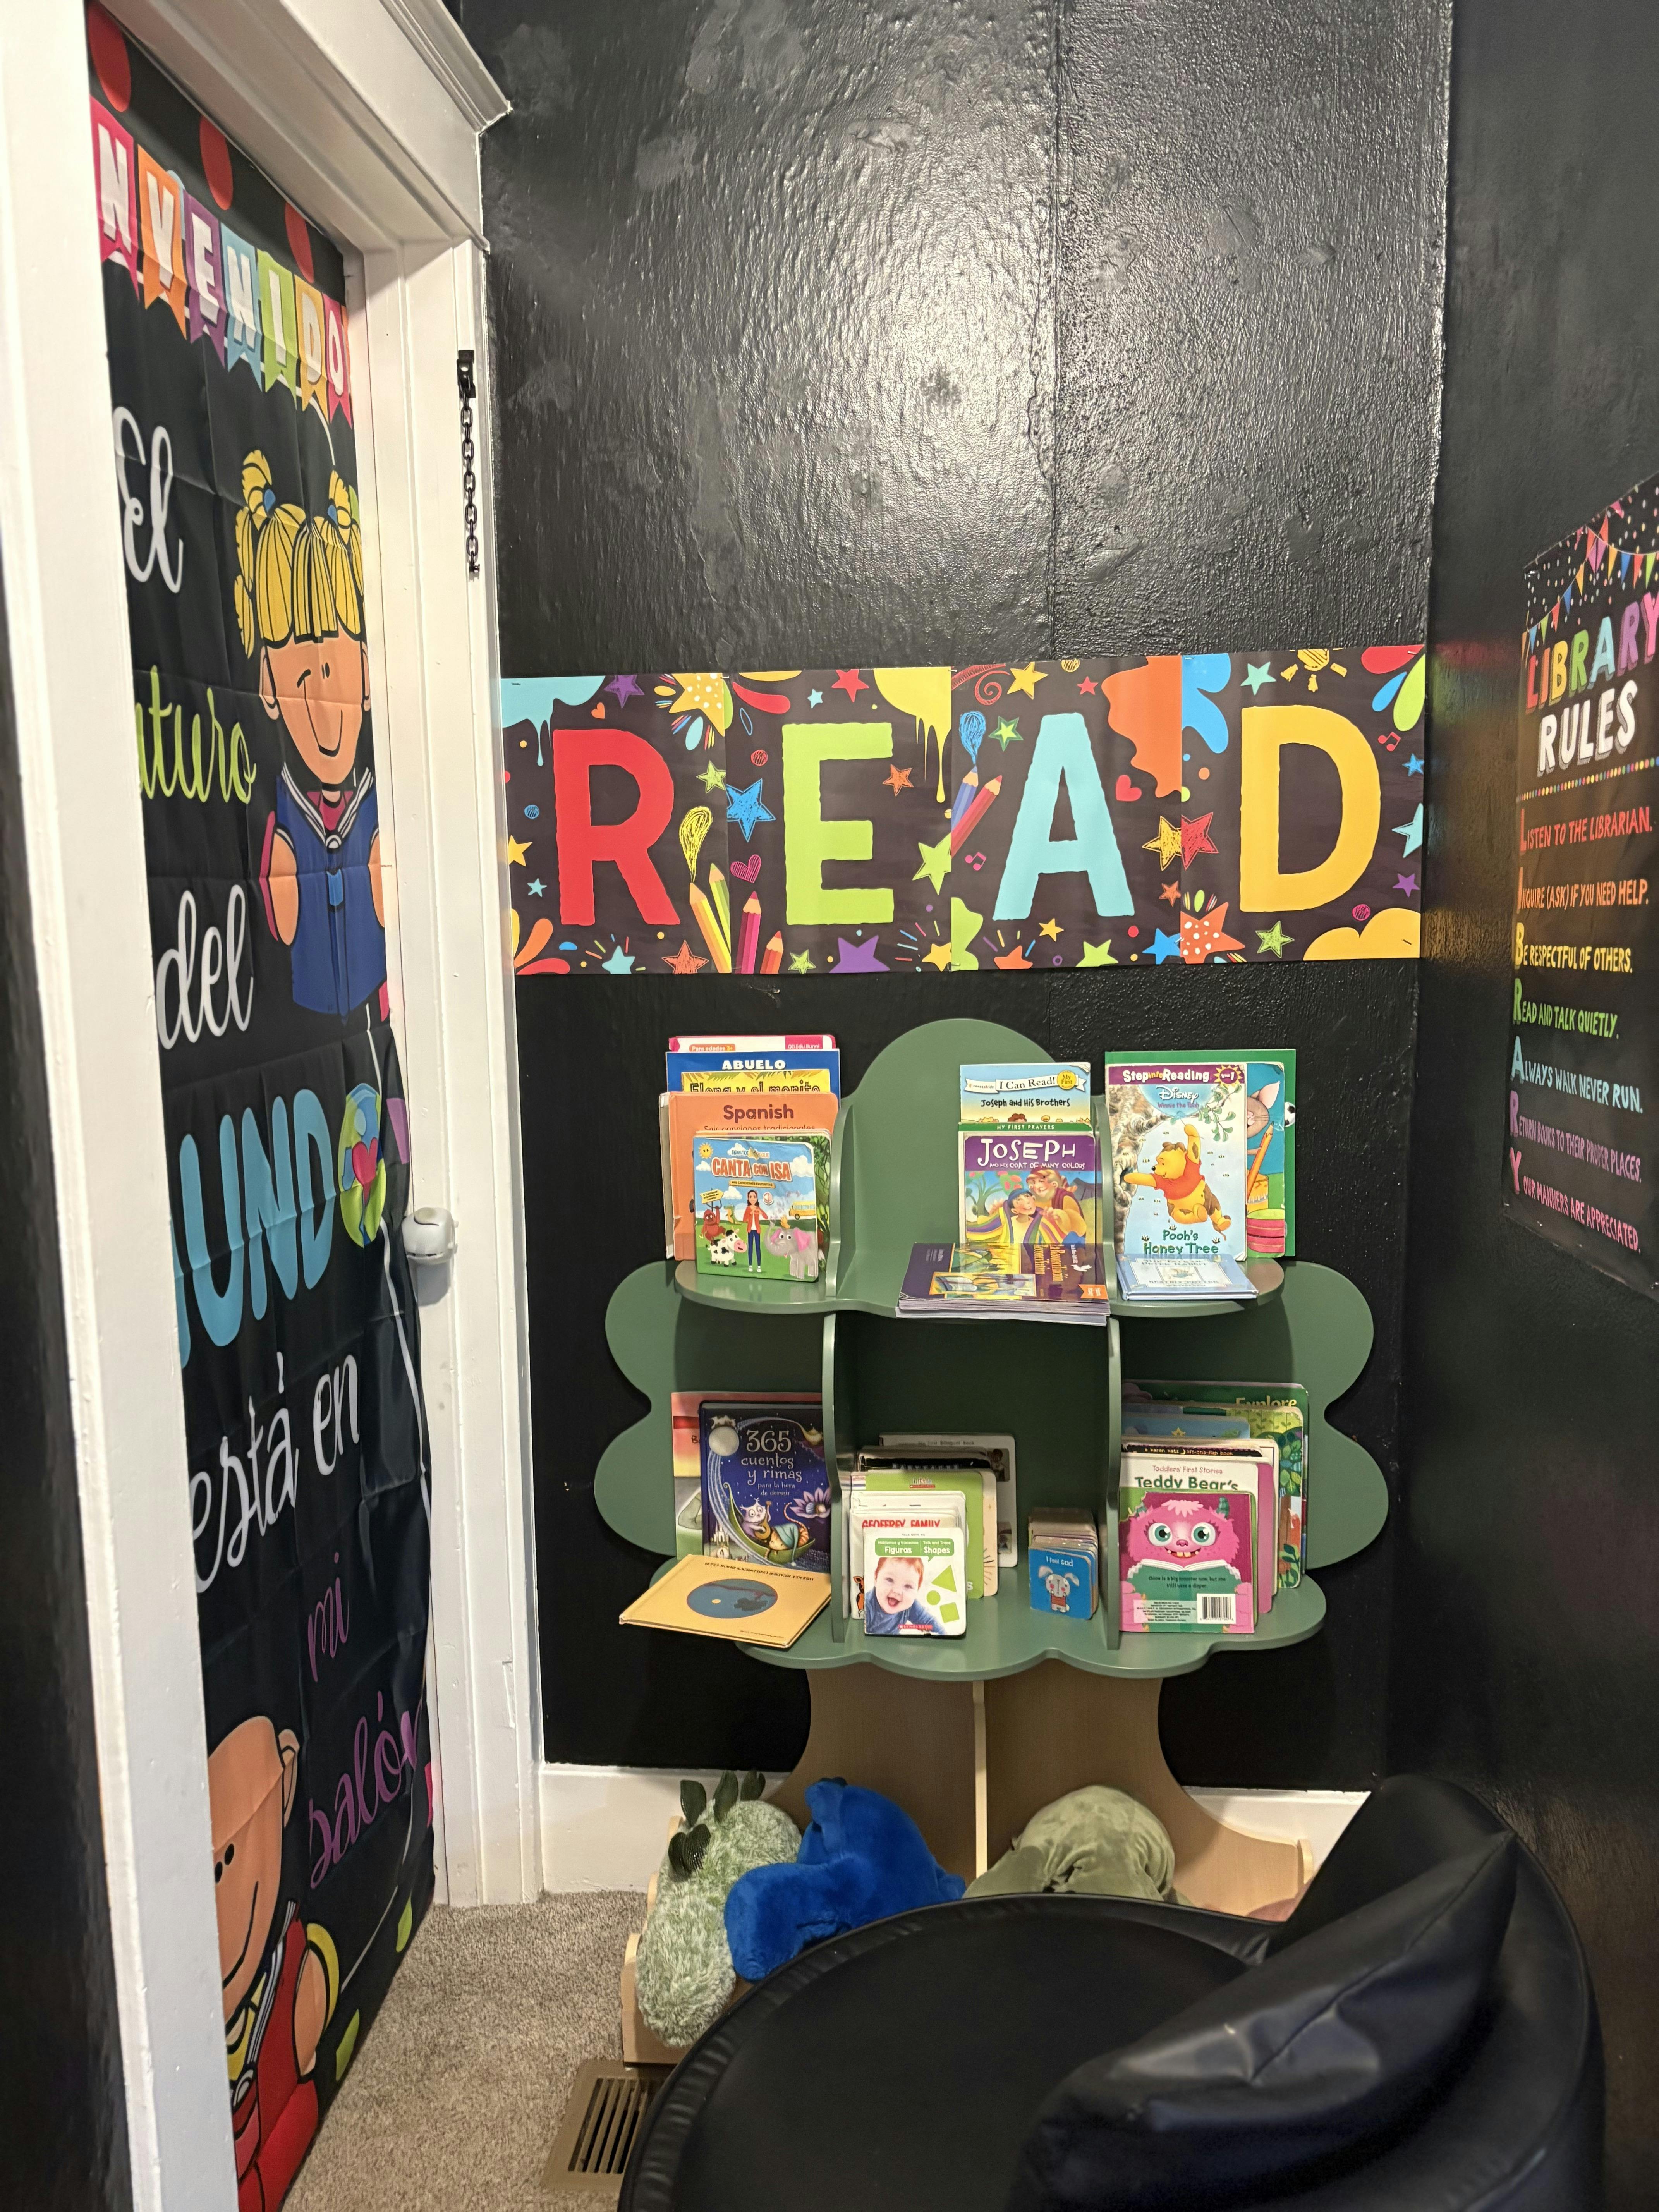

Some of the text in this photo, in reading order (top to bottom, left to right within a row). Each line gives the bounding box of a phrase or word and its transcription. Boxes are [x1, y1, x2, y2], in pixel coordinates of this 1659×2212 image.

[113, 407, 183, 593] El
[1527, 592, 1659, 712] LIBRARY
[1538, 680, 1637, 774] RULES
[553, 705, 1381, 925] READ
[1520, 806, 1652, 852] LISTEN TO THE LIBRARIAN.
[1517, 867, 1649, 911] INQUIRE (ASK) IF YOU NEED HELP.
[1515, 922, 1633, 973] BE RESPECTFUL OF OTHERS.
[156, 885, 253, 1049] del
[1513, 978, 1619, 1039] READ AND TALK QUIETLY.
[722, 1060, 786, 1070] ABUELO
[1123, 1068, 1209, 1083] Step into Reading
[1511, 1036, 1643, 1113] ALWAYS WALK NEVER RUN.
[1028, 1077, 1055, 1087] Read!
[723, 1104, 794, 1123] Spanish
[981, 1099, 1007, 1108] Joseph
[1024, 1099, 1034, 1107] His
[1036, 1098, 1070, 1107] Brothers
[1510, 1089, 1642, 1183] RETURN BOOKS TO THEIR PROPER PLACES.
[977, 1138, 1075, 1166] JOSEPH
[712, 1158, 751, 1177] CANTA
[770, 1162, 792, 1181] ISA
[1510, 1147, 1641, 1254] YOUR MANNERS ARE APPRECIATED.
[1163, 1229, 1198, 1241] Pooh's
[1144, 1243, 1219, 1255] Honey Tree
[313, 1355, 360, 1475] en
[746, 1431, 792, 1452] 365
[741, 1453, 793, 1468] cuentos
[748, 1466, 802, 1485] y rimas
[1135, 1475, 1238, 1490] Teddy Bear's
[884, 1546, 912, 1554] Figuras
[924, 1546, 950, 1554] Shapes
[1061, 1559, 1073, 1567] sad
[308, 1552, 349, 1682] mi
